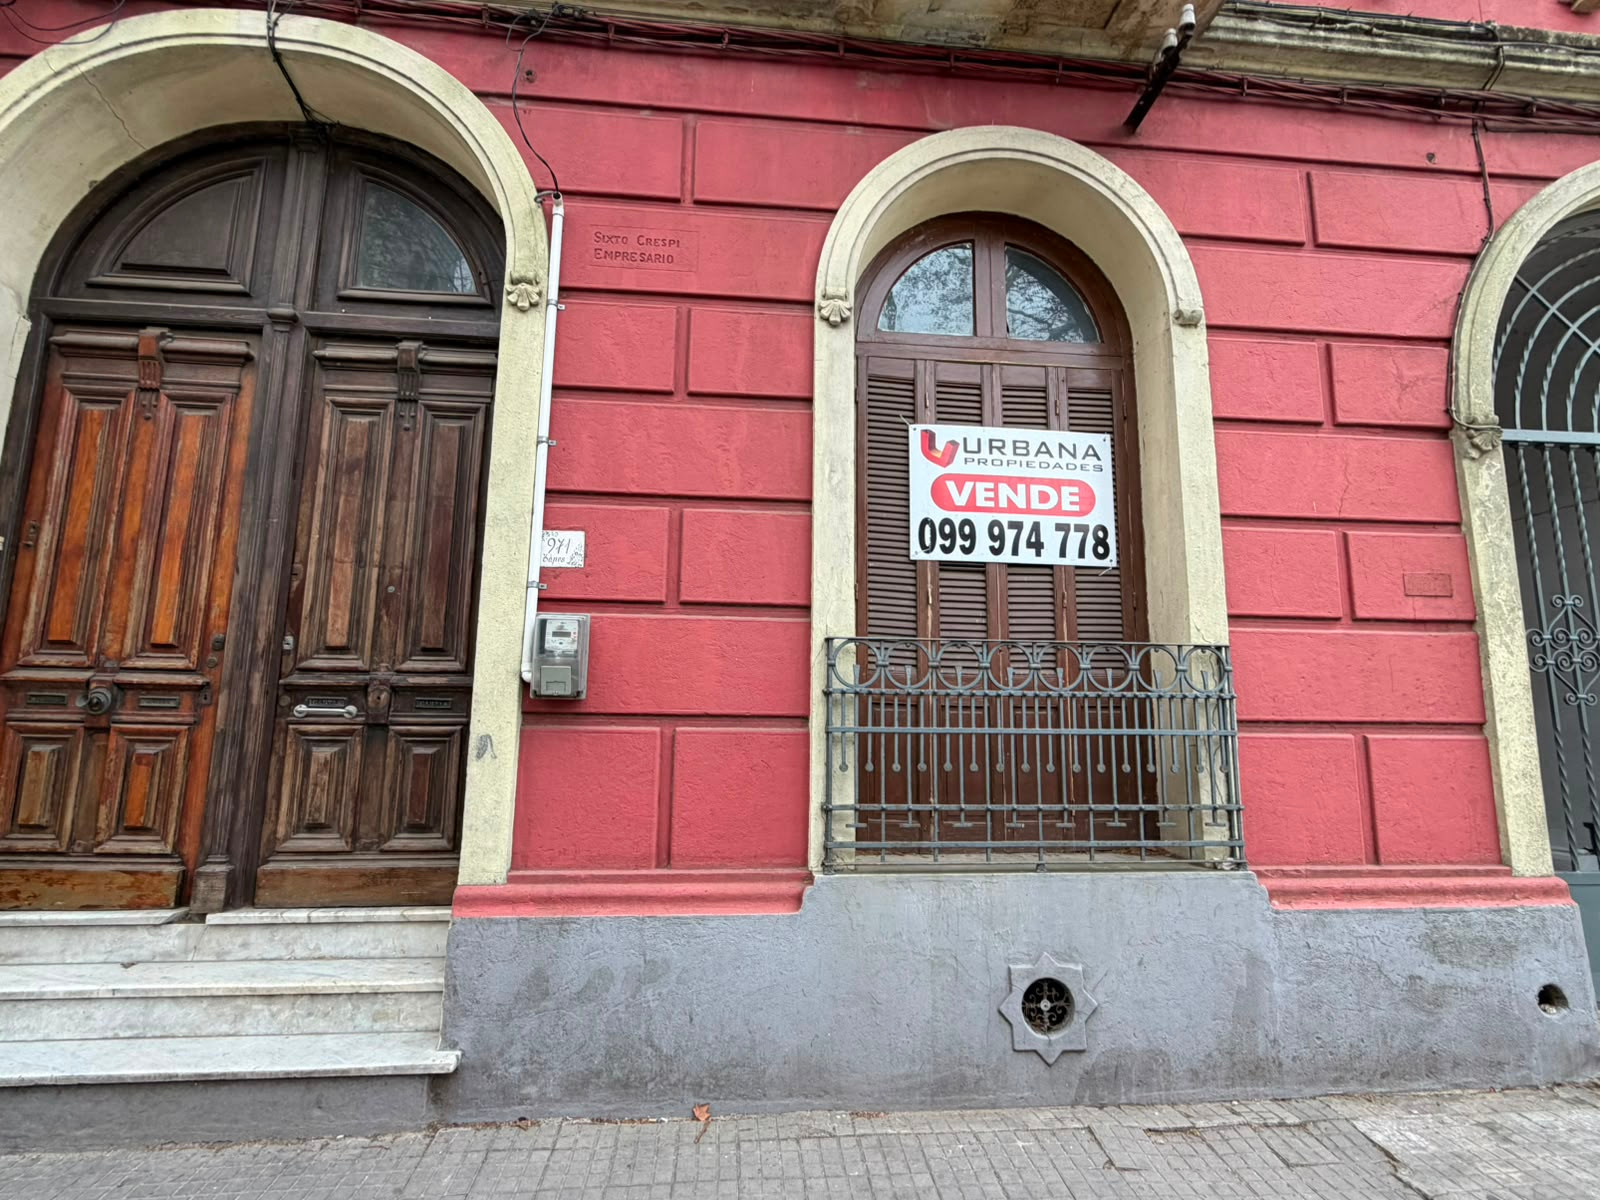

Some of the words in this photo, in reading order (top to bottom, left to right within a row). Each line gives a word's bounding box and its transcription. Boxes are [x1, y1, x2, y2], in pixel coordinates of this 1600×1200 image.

[593, 231, 629, 245] SIXTO
[636, 234, 680, 248] CRESPI
[593, 247, 675, 265] EMPRESARIO
[962, 436, 1103, 462] URBANA
[963, 457, 1104, 473] PROPIEDADES
[945, 479, 1081, 512] VENDE
[547, 537, 571, 555] 971
[918, 516, 977, 555] 099
[987, 519, 1045, 557] 974
[1054, 522, 1111, 560] 778
